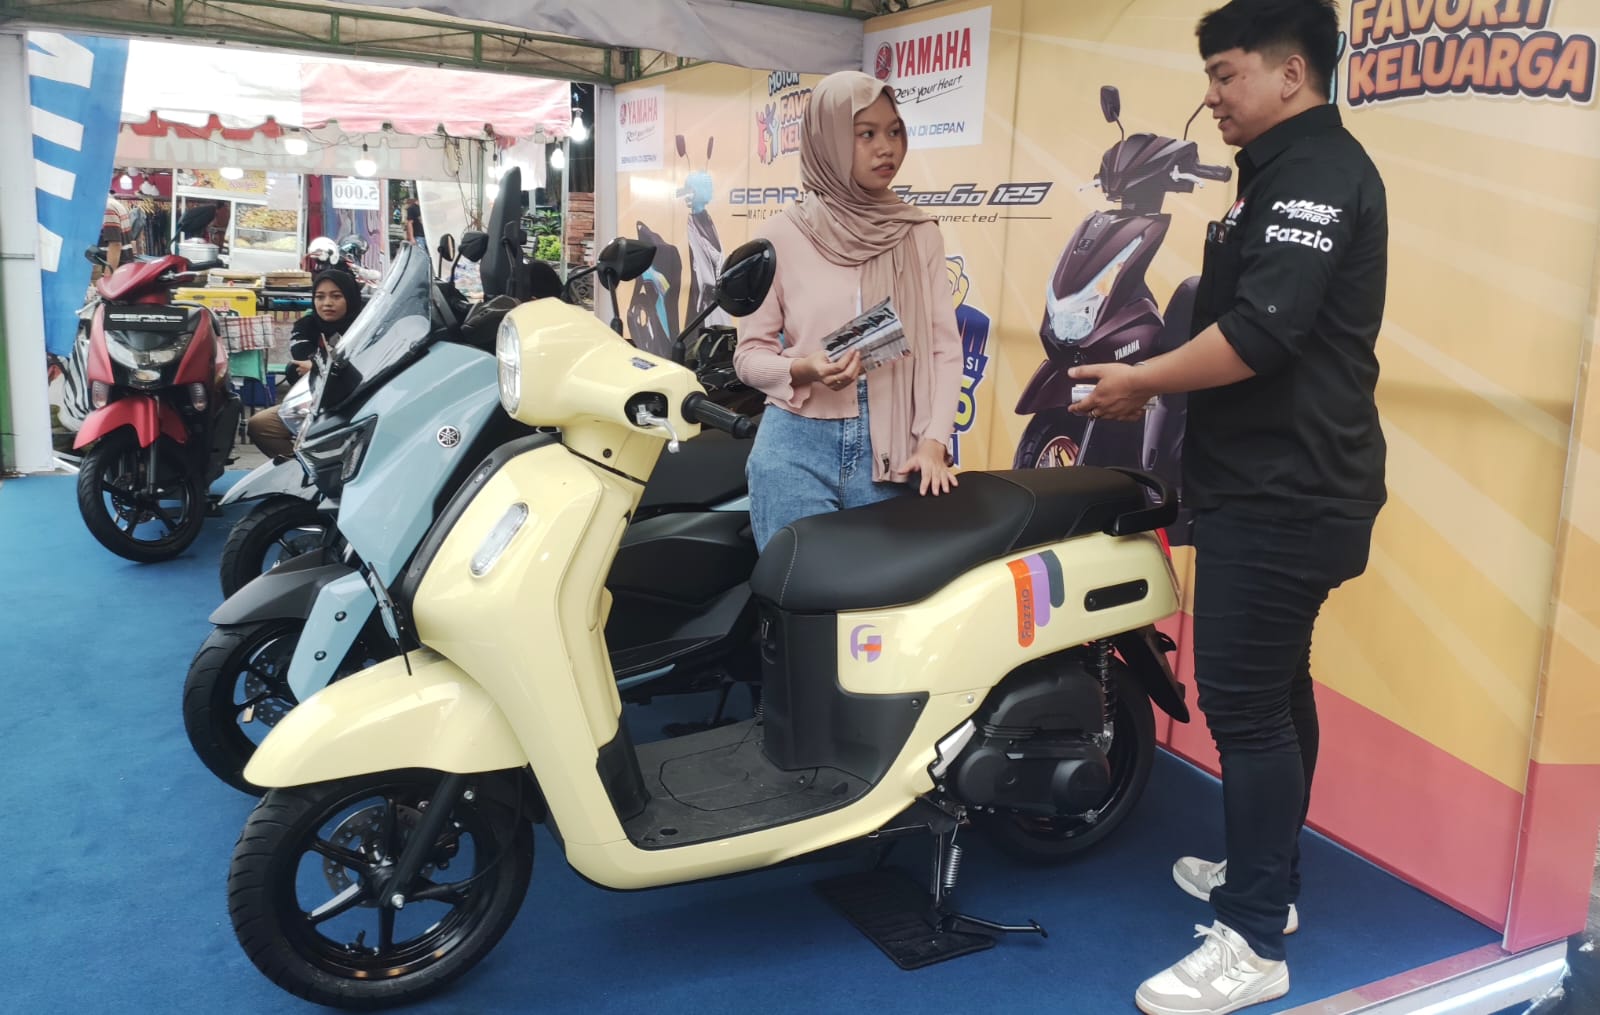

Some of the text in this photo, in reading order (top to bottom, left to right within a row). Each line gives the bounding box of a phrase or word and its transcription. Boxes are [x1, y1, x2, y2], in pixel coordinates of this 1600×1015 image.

[896, 27, 971, 78] YAMAHA
[1348, 32, 1595, 104] KELUARGA
[928, 121, 965, 136] DEPAN
[729, 187, 799, 204] GEAR
[990, 182, 1052, 205] 125
[1265, 224, 1334, 253] Fazzio
[1113, 339, 1141, 361] YAMAHA
[1021, 588, 1033, 640] Fazzio
